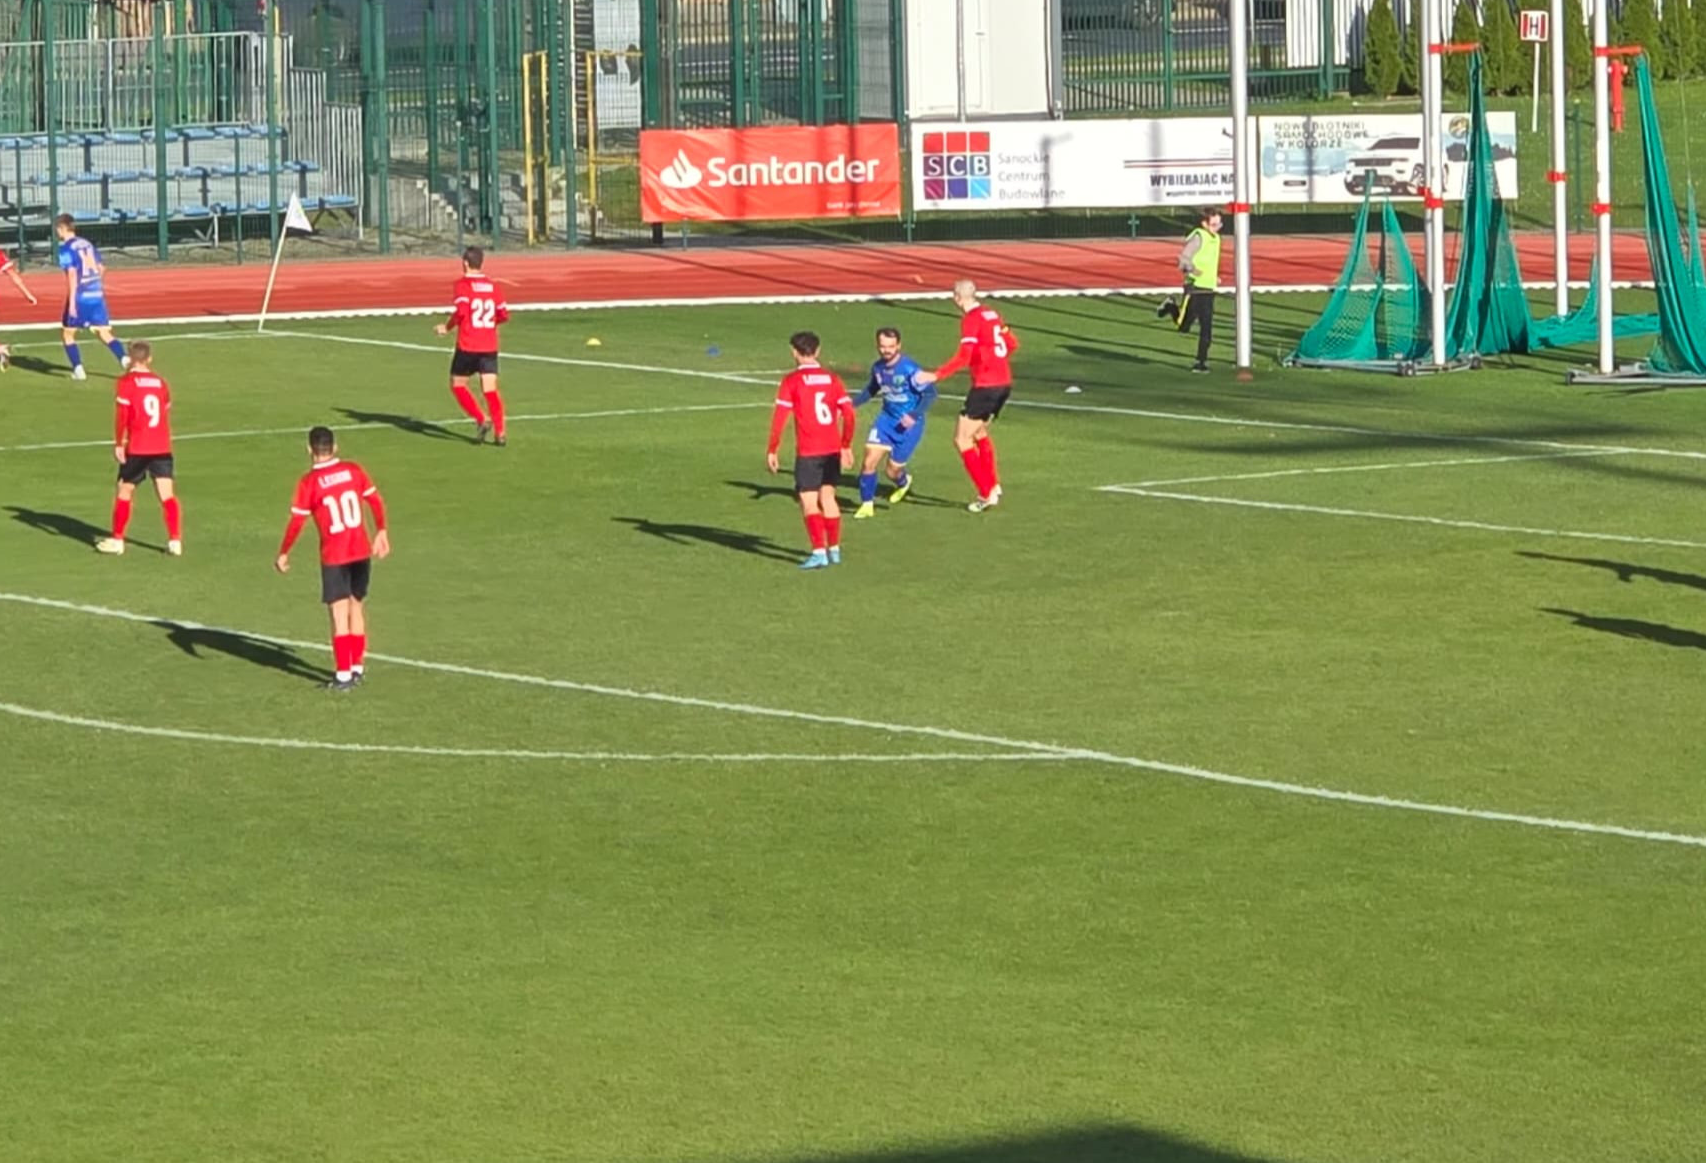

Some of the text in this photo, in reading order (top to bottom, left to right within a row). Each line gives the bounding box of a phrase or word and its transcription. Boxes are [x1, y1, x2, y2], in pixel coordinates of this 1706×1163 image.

[1529, 15, 1539, 36] H
[707, 154, 880, 188] Santander
[927, 155, 988, 177] SCB
[998, 152, 1050, 164] Sanockie
[998, 170, 1050, 182] Centrum
[1150, 172, 1218, 188] WYBIERAJĄC
[999, 188, 1066, 200] Budowlane
[471, 298, 495, 329] 22
[993, 324, 1008, 358] 5
[144, 394, 160, 428] 9
[815, 391, 833, 425] 6
[322, 490, 362, 535] 10
